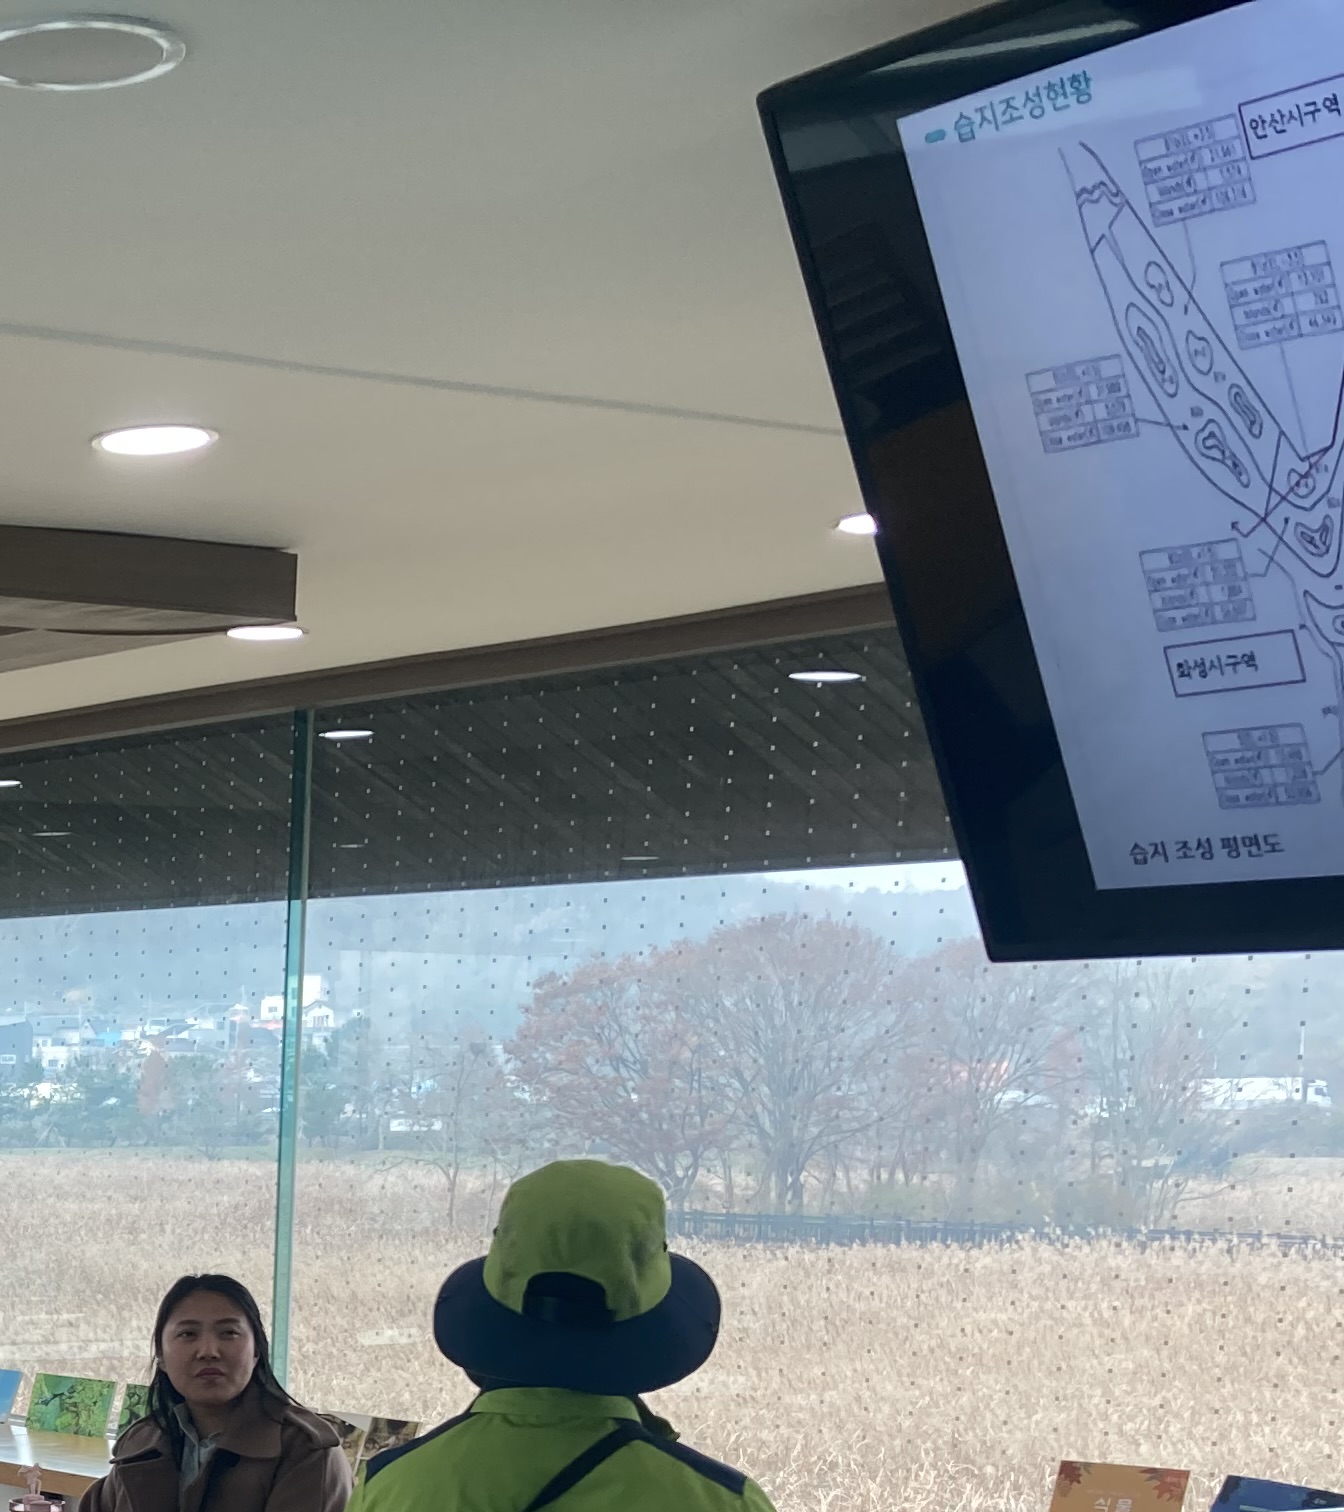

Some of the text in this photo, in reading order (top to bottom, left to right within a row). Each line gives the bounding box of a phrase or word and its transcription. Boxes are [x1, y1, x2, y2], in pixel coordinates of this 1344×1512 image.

[953, 69, 1093, 143] 습지조성현황
[1249, 92, 1342, 140] 안산시구역
[1175, 650, 1259, 680] 화성시구역
[1129, 841, 1169, 866] 습지
[1174, 837, 1215, 861] 조성
